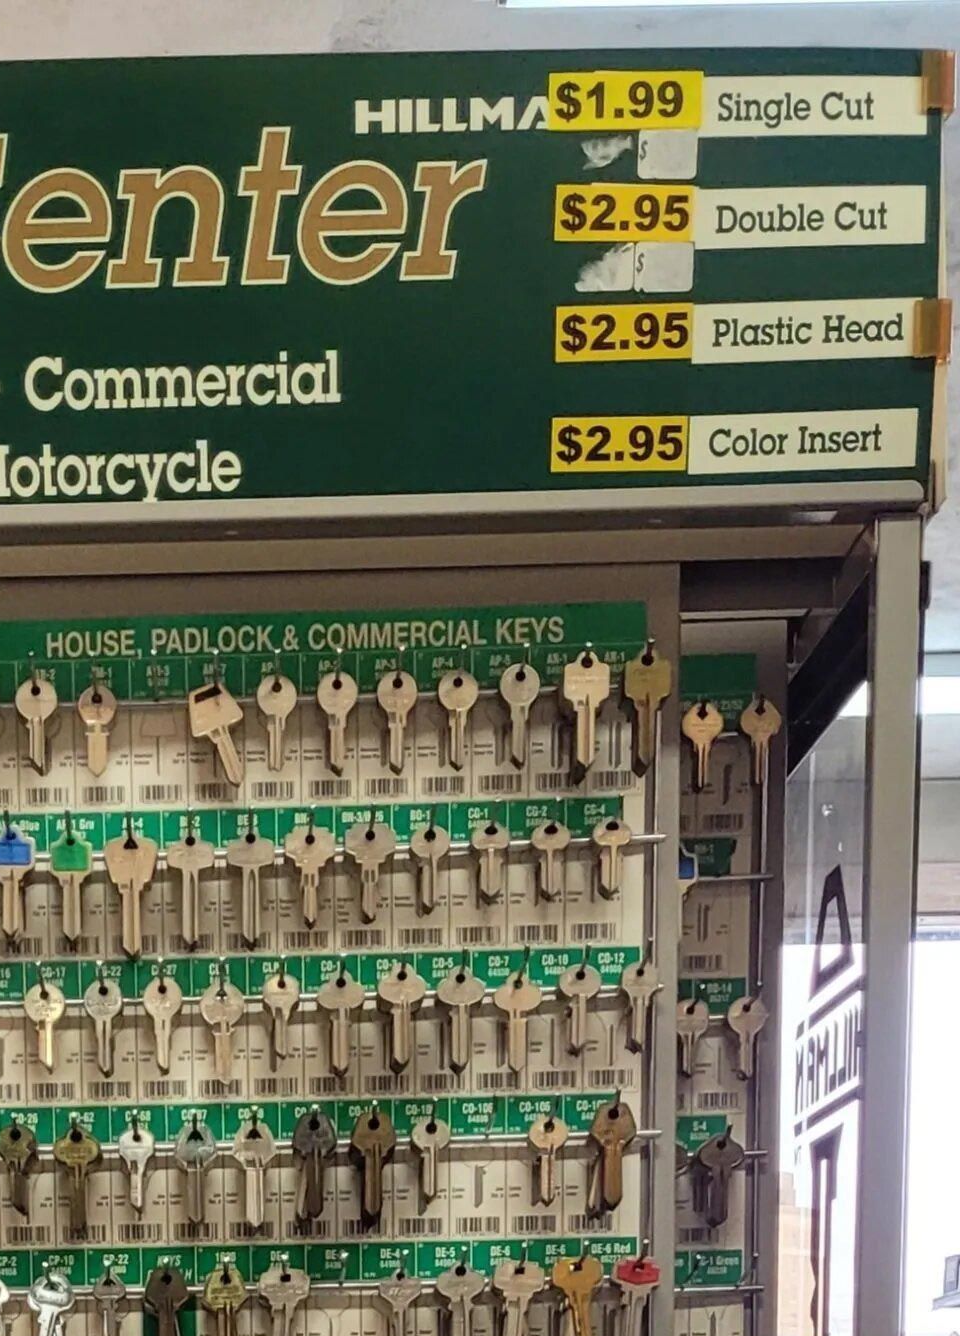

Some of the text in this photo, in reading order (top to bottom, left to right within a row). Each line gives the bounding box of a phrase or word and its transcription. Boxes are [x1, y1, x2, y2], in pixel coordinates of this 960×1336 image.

[355, 96, 548, 134] HILLMA
[555, 81, 685, 122] $1.99
[716, 91, 875, 128] Single Cut
[560, 193, 690, 234] $2.95
[715, 203, 889, 235] Double Cut
[561, 310, 689, 352] $2.95
[711, 314, 905, 349] Plastic Head
[24, 351, 341, 411] Commercial
[555, 421, 684, 464] $2.95
[708, 426, 883, 458] Color Insert
[46, 616, 565, 660] HOUSE, PADLOCK & COMMERCIAL KEYS
[614, 1243, 630, 1254] Red
